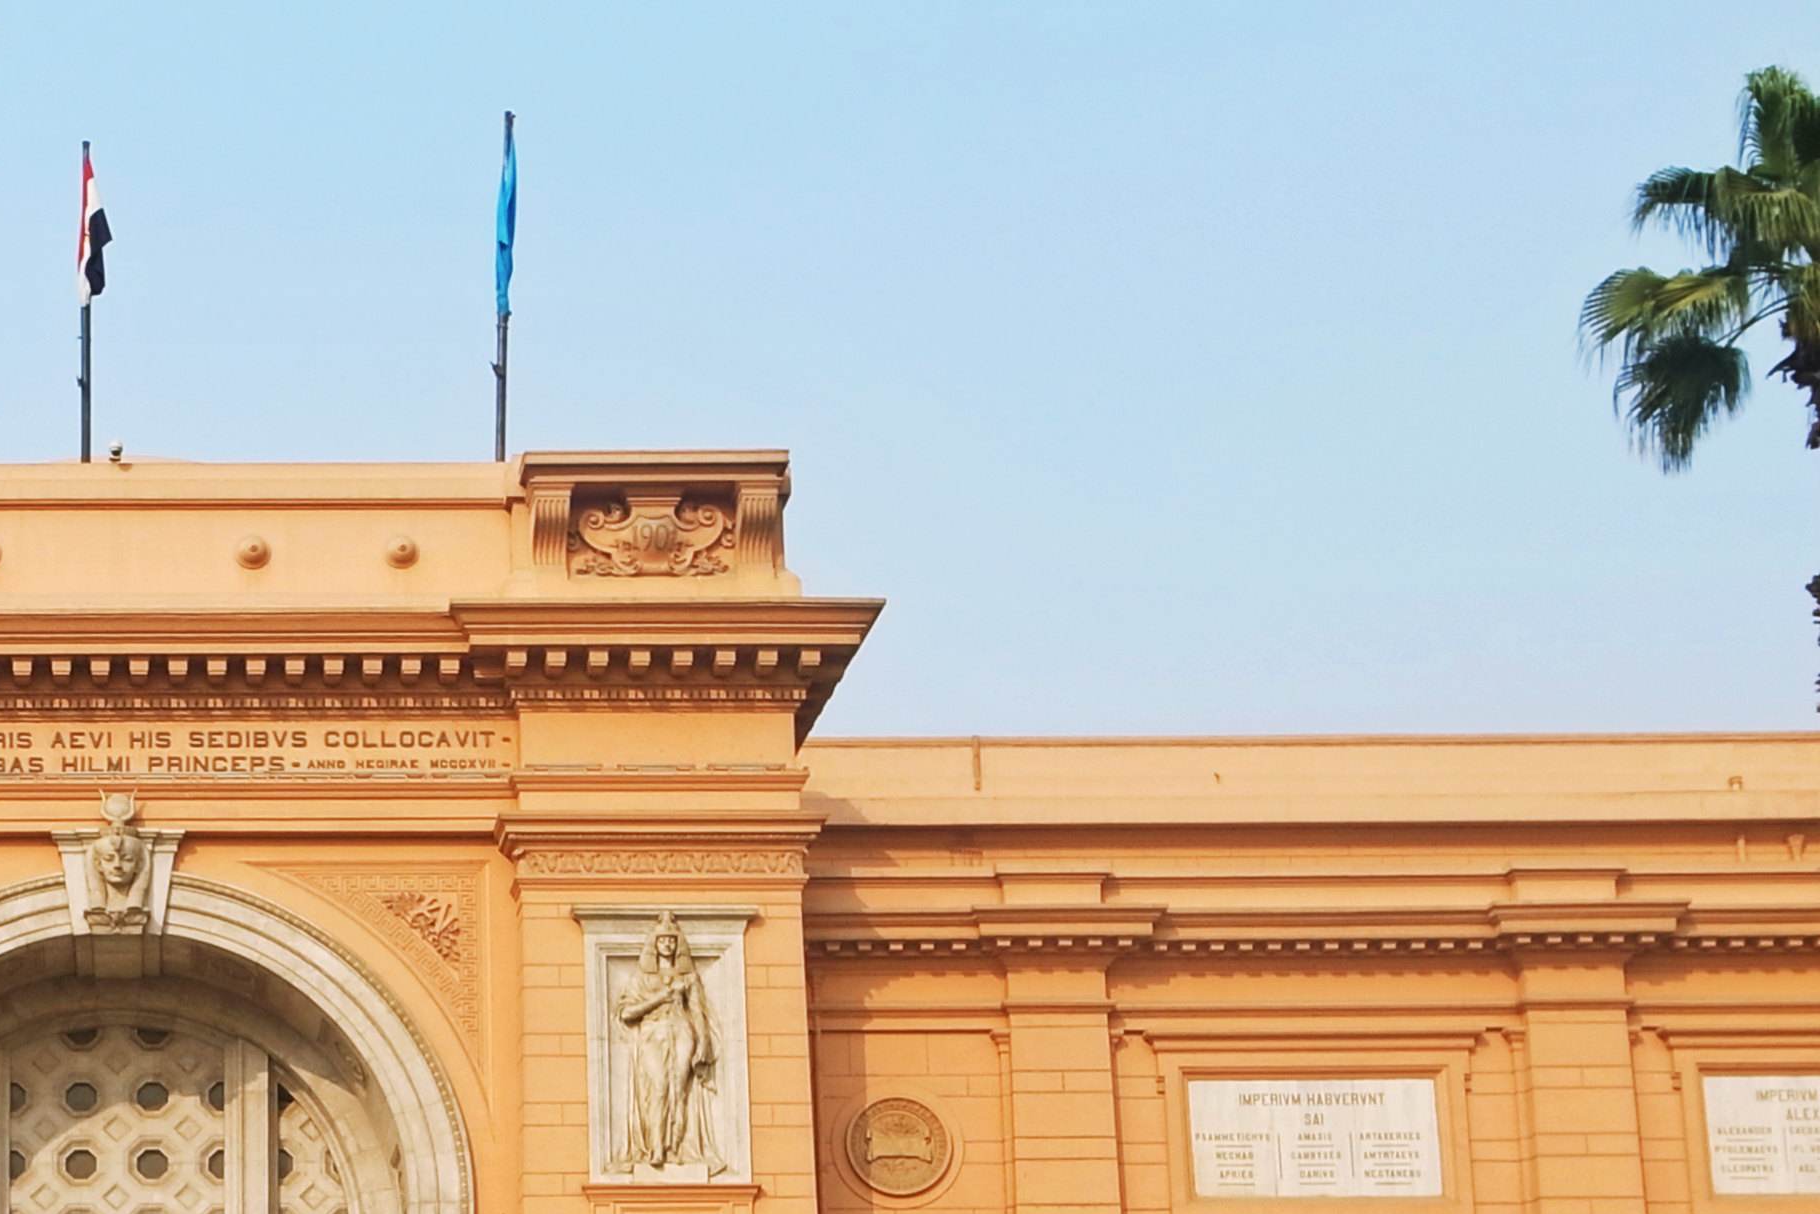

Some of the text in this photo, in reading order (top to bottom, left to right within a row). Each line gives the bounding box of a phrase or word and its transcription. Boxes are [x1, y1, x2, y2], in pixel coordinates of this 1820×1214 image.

[50, 731, 113, 749] AEVI
[130, 730, 172, 749] HIS
[188, 730, 308, 749] SEDIBVS
[324, 730, 496, 749] COLLOCAVIT
[61, 756, 131, 773] HILMI
[147, 755, 286, 773] PRINCEPS
[307, 759, 346, 769] ANNO
[1238, 1092, 1385, 1106] IMPERIVM HABVERVNT
[1304, 1112, 1324, 1126] SAI
